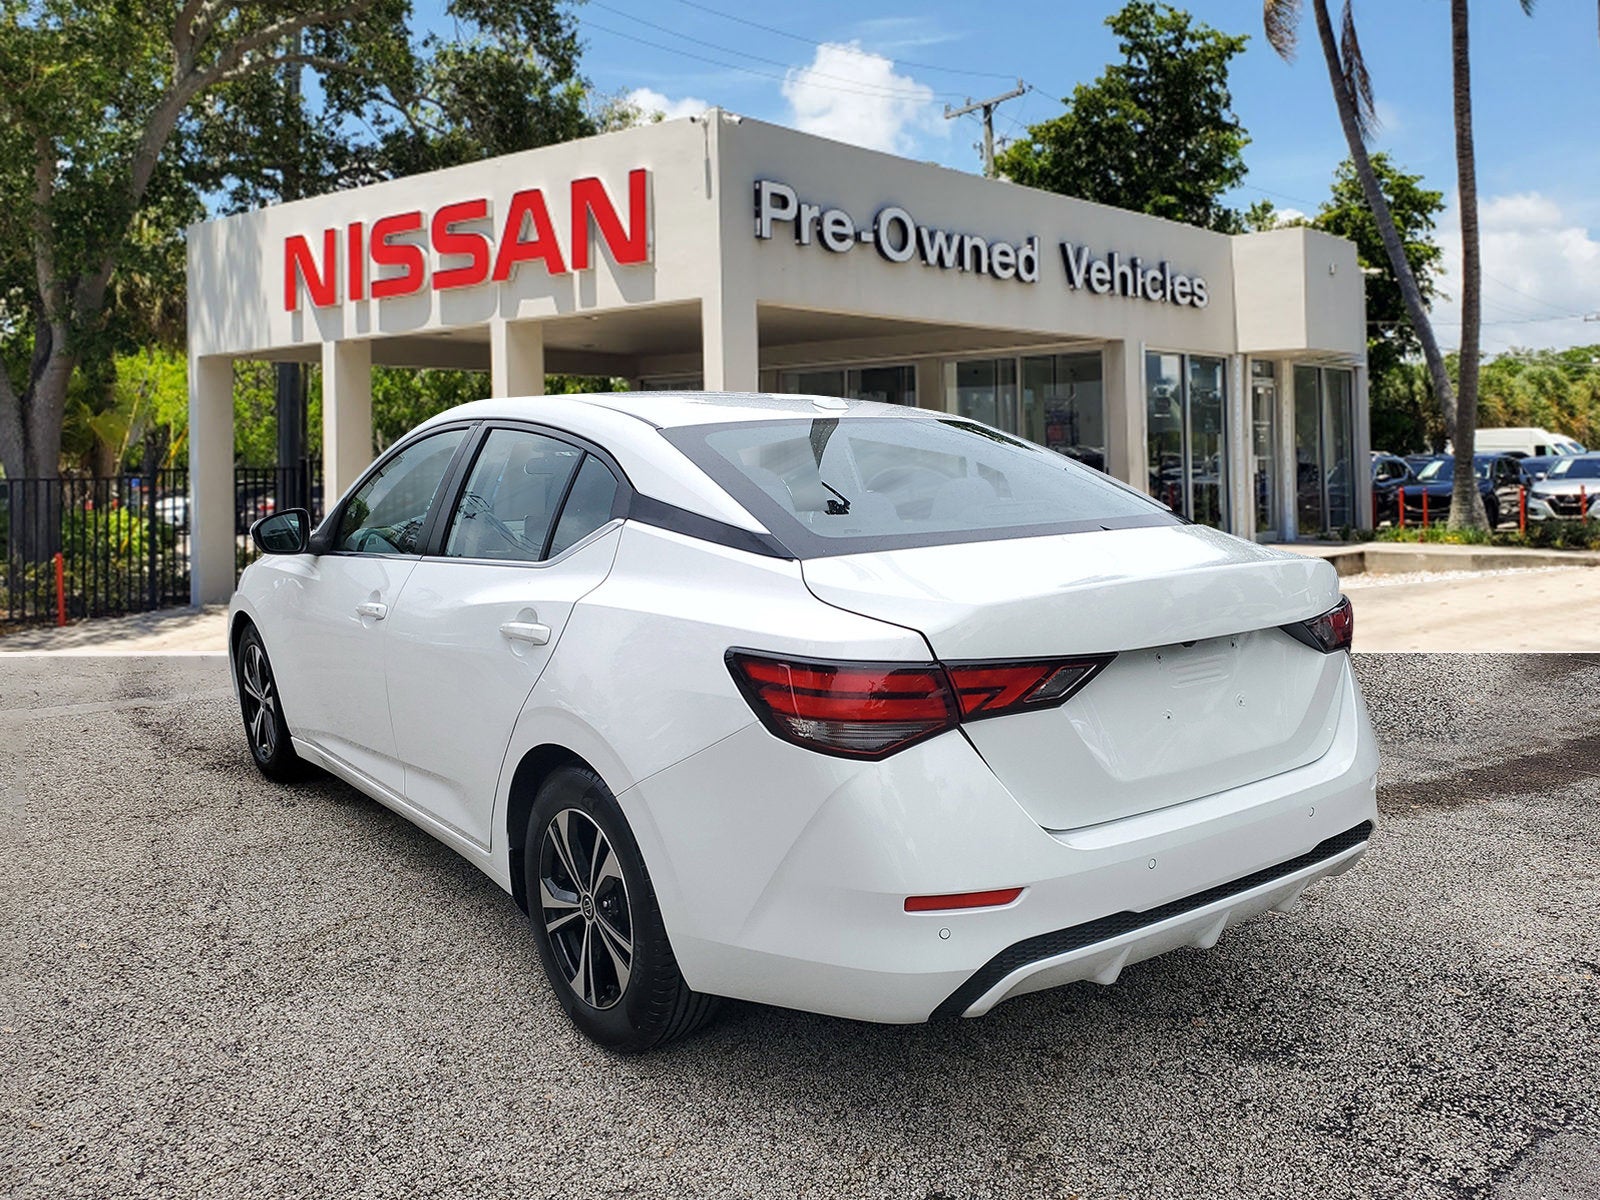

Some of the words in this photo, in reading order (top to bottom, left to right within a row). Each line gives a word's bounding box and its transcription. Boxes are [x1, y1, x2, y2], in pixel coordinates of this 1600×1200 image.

[284, 168, 647, 312] NISSAN
[754, 180, 1040, 283] Pre-Owned
[1060, 242, 1208, 308] Vehicles
